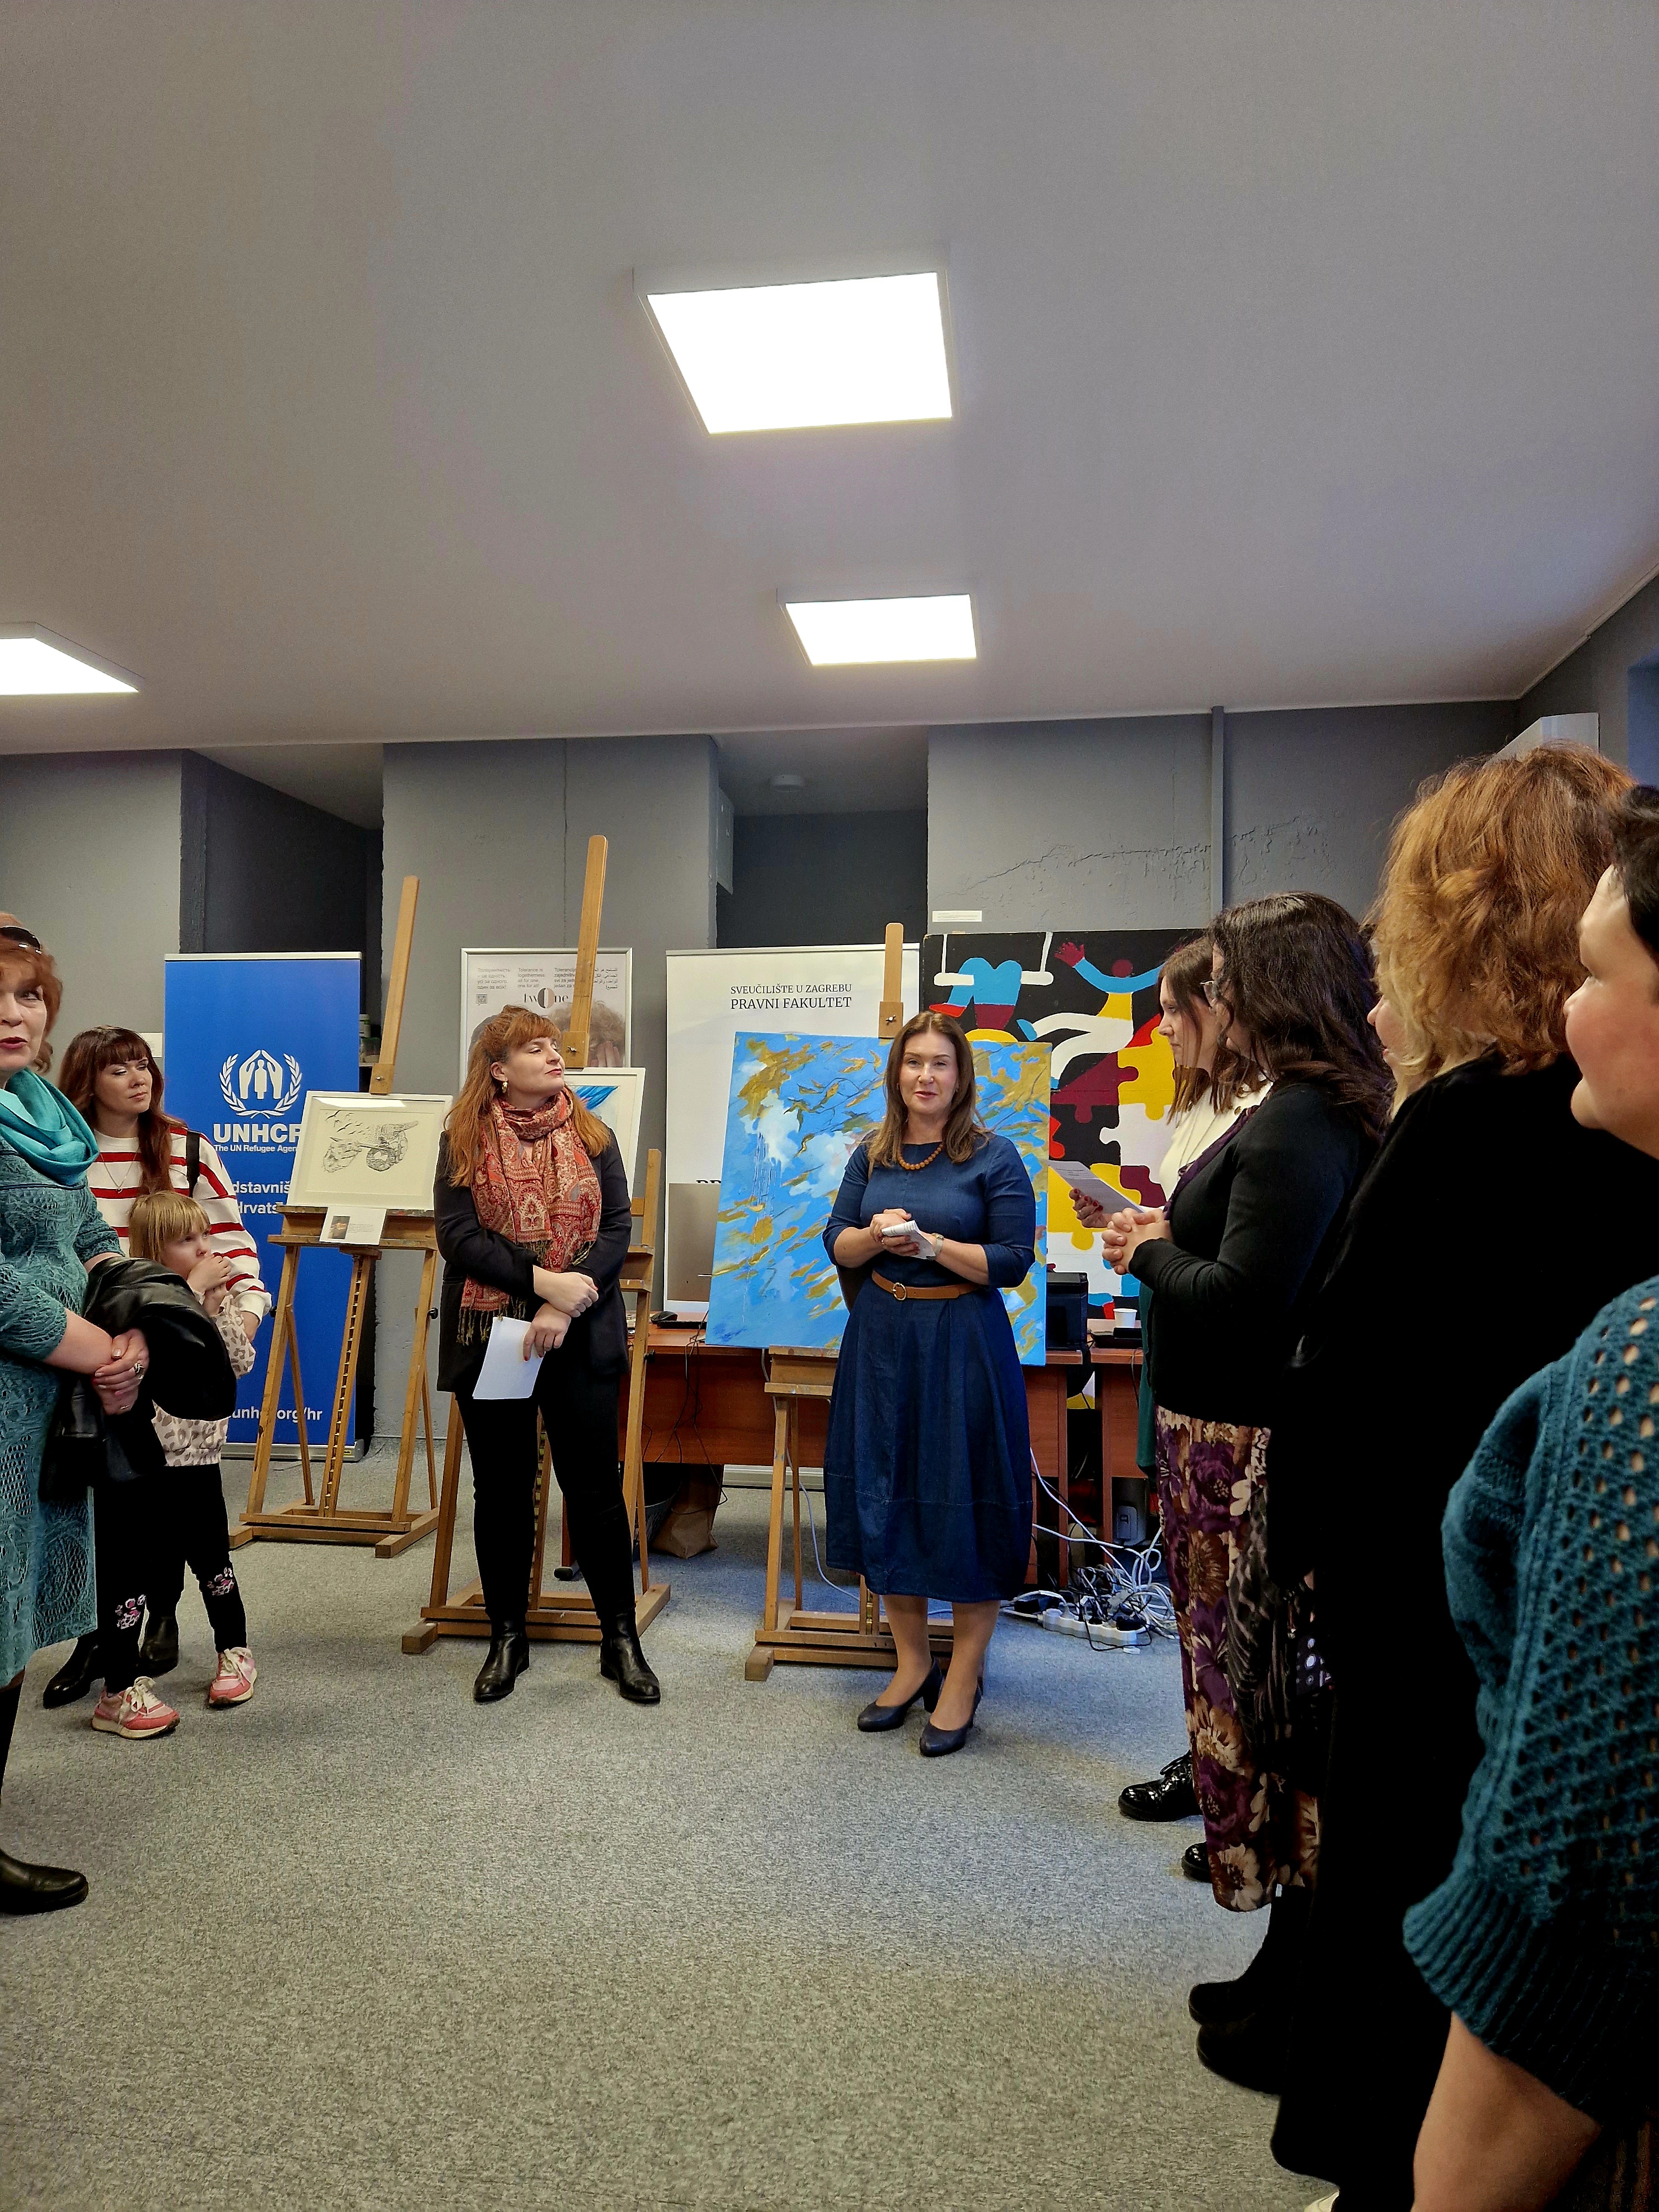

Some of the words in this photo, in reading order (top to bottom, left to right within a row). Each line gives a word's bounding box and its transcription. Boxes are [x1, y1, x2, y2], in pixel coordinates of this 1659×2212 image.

[731, 983, 794, 994] SVEUČILIŠTE
[805, 984, 852, 993] ZAGREBU
[731, 998, 779, 1009] PRAVNI
[783, 997, 852, 1009] FAKULTET
[243, 1145, 275, 1153] Refugee
[277, 1145, 297, 1153] Agen
[232, 1181, 290, 1193] dstavniš
